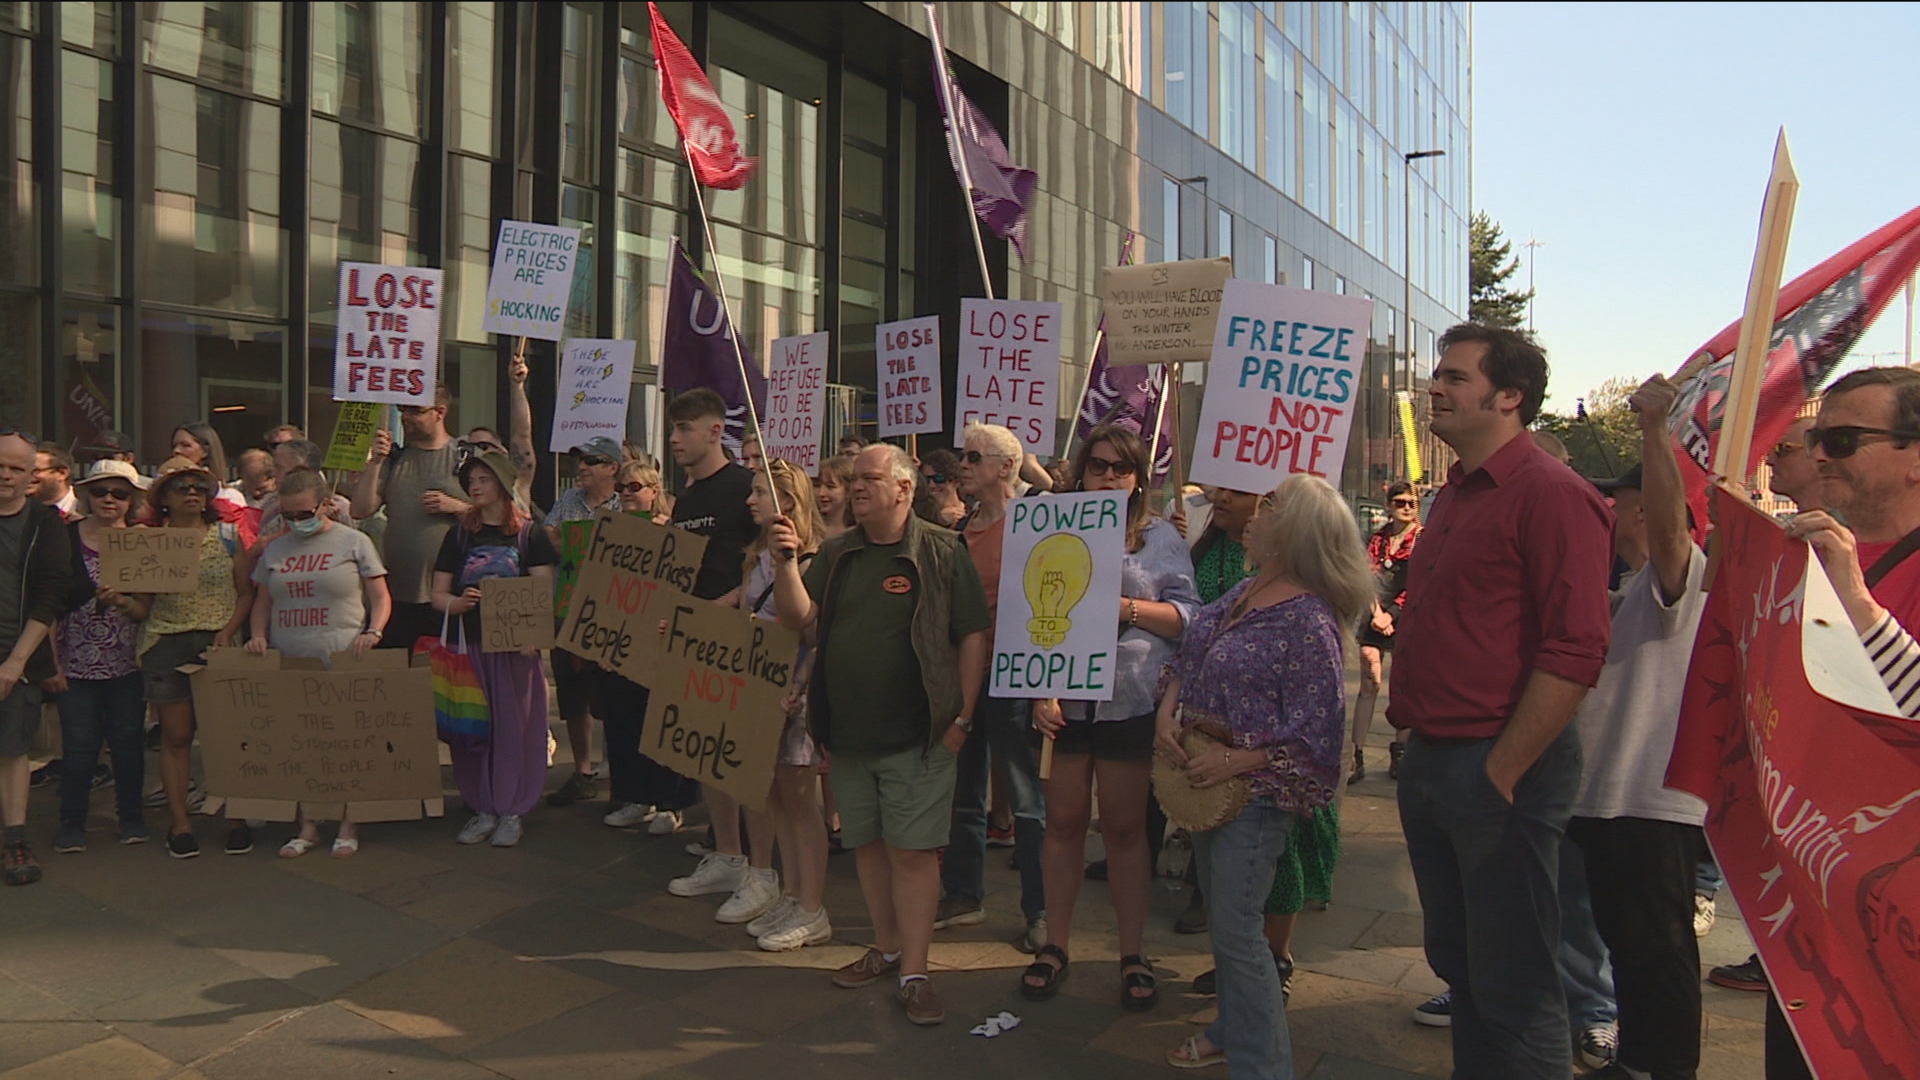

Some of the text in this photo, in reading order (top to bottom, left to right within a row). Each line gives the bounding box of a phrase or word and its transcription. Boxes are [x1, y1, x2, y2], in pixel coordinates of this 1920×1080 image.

[502, 228, 575, 251] ELECTRIC
[505, 248, 568, 272] PRICES
[514, 268, 545, 285] ARE
[1152, 268, 1169, 281] OR
[347, 268, 435, 309] LOSE
[1111, 288, 1223, 305] YOU WILL HAVE BLOOD
[366, 311, 408, 333] THE
[1122, 306, 1210, 319] ON YOUR HANDS
[970, 310, 1050, 342] LOSE
[1152, 322, 1191, 334] WINTER
[346, 332, 425, 360] LATE
[885, 328, 933, 351] LOSE
[1227, 316, 1354, 361] FREEZE
[785, 342, 810, 366] WE
[887, 356, 915, 375] THE
[978, 347, 1032, 371] THE
[348, 362, 425, 395] FEES
[575, 380, 600, 388] ARE
[770, 368, 821, 391] REFUSE
[885, 376, 931, 399] LATE
[966, 374, 1045, 406] LATE
[1238, 356, 1353, 403] PRICES
[772, 392, 813, 413] TO BE
[886, 401, 927, 426] FEES
[1269, 396, 1343, 434] NOT
[768, 416, 812, 439] POOR
[1212, 421, 1334, 478] PEOPLE
[1012, 499, 1118, 533] POWER
[108, 532, 195, 552] HEATING
[140, 554, 159, 566] OR
[281, 553, 333, 573] SAVE
[589, 516, 653, 576] Freeze
[653, 531, 695, 594] Prices
[120, 565, 190, 582] EATING
[286, 580, 315, 598] THE
[483, 579, 549, 610] People
[606, 572, 658, 616] NOT
[278, 607, 329, 628] FUTURE
[1038, 620, 1056, 631] TO
[490, 627, 522, 648] OIL
[569, 594, 632, 668] People
[1035, 635, 1055, 643] THE
[667, 605, 789, 688] Freeze Prices
[995, 652, 1107, 690] PEOPLE
[215, 677, 387, 709] THE POWER
[684, 667, 746, 711] NOT
[251, 710, 415, 731] OF THE PEOPLE
[291, 735, 376, 752] STRONGER
[657, 703, 742, 781] People
[279, 760, 308, 776] THE
[321, 756, 377, 775] PEOPLE
[393, 758, 411, 771] IN
[305, 778, 365, 794] POWER
